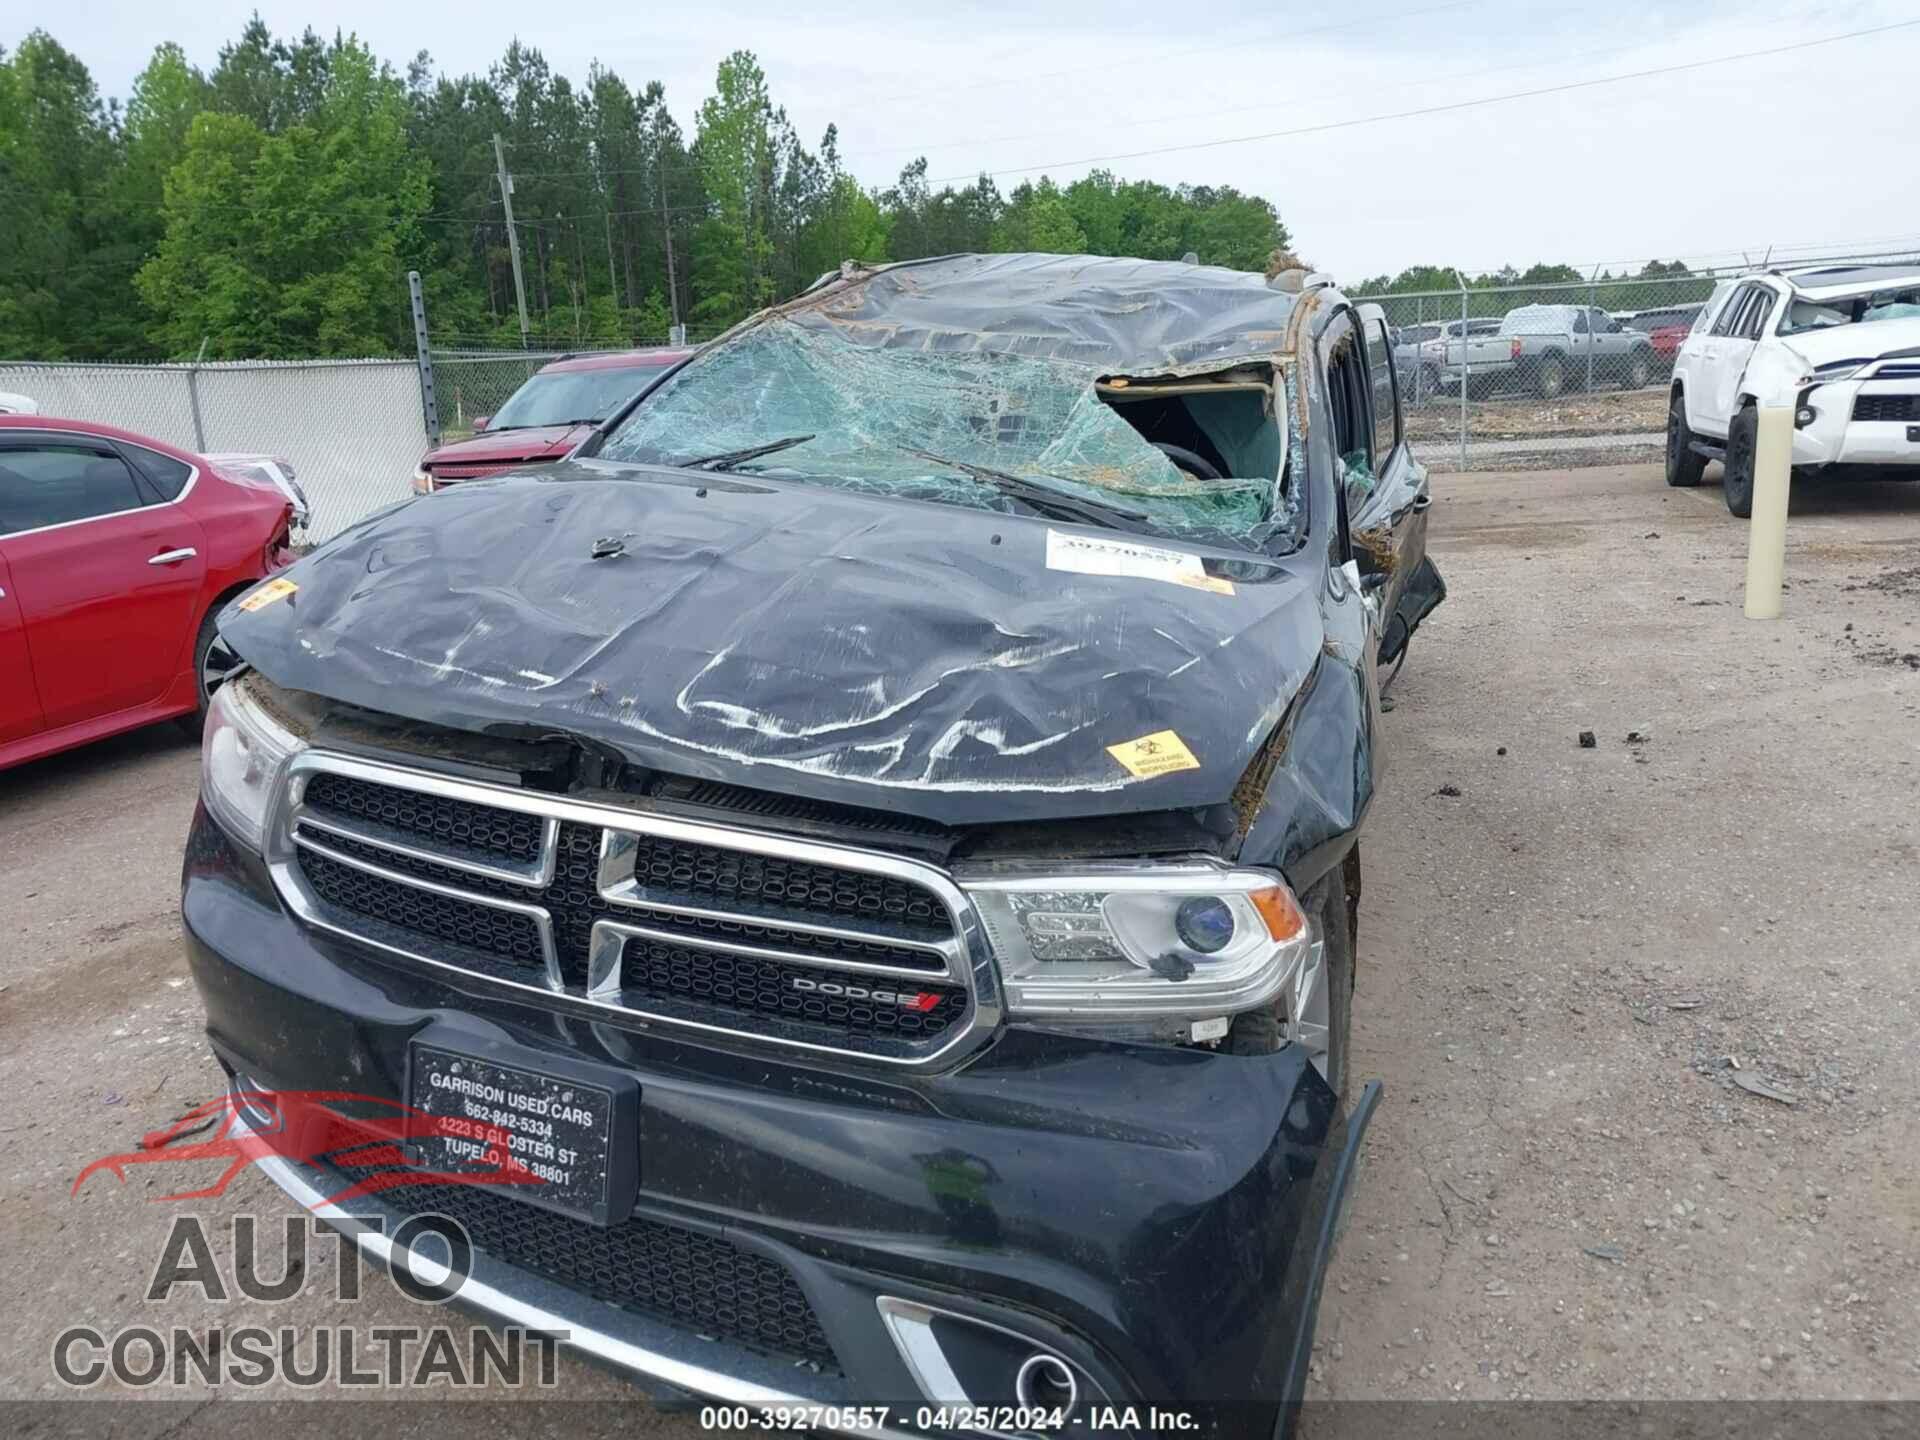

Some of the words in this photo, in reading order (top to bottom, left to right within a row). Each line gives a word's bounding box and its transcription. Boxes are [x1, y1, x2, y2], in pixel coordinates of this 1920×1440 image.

[793, 978, 921, 1007] DODGE
[430, 1072, 504, 1103] GARRISON
[508, 1095, 548, 1114] USED
[551, 1104, 593, 1127] CARS
[465, 1102, 552, 1137] 662-842-5334
[443, 1137, 502, 1167] TUPELO,
[507, 1154, 529, 1173] MS
[532, 1161, 569, 1185] 38801
[474, 1125, 484, 1140] S
[487, 1127, 555, 1160] GLOSTER
[558, 1148, 578, 1166] ST
